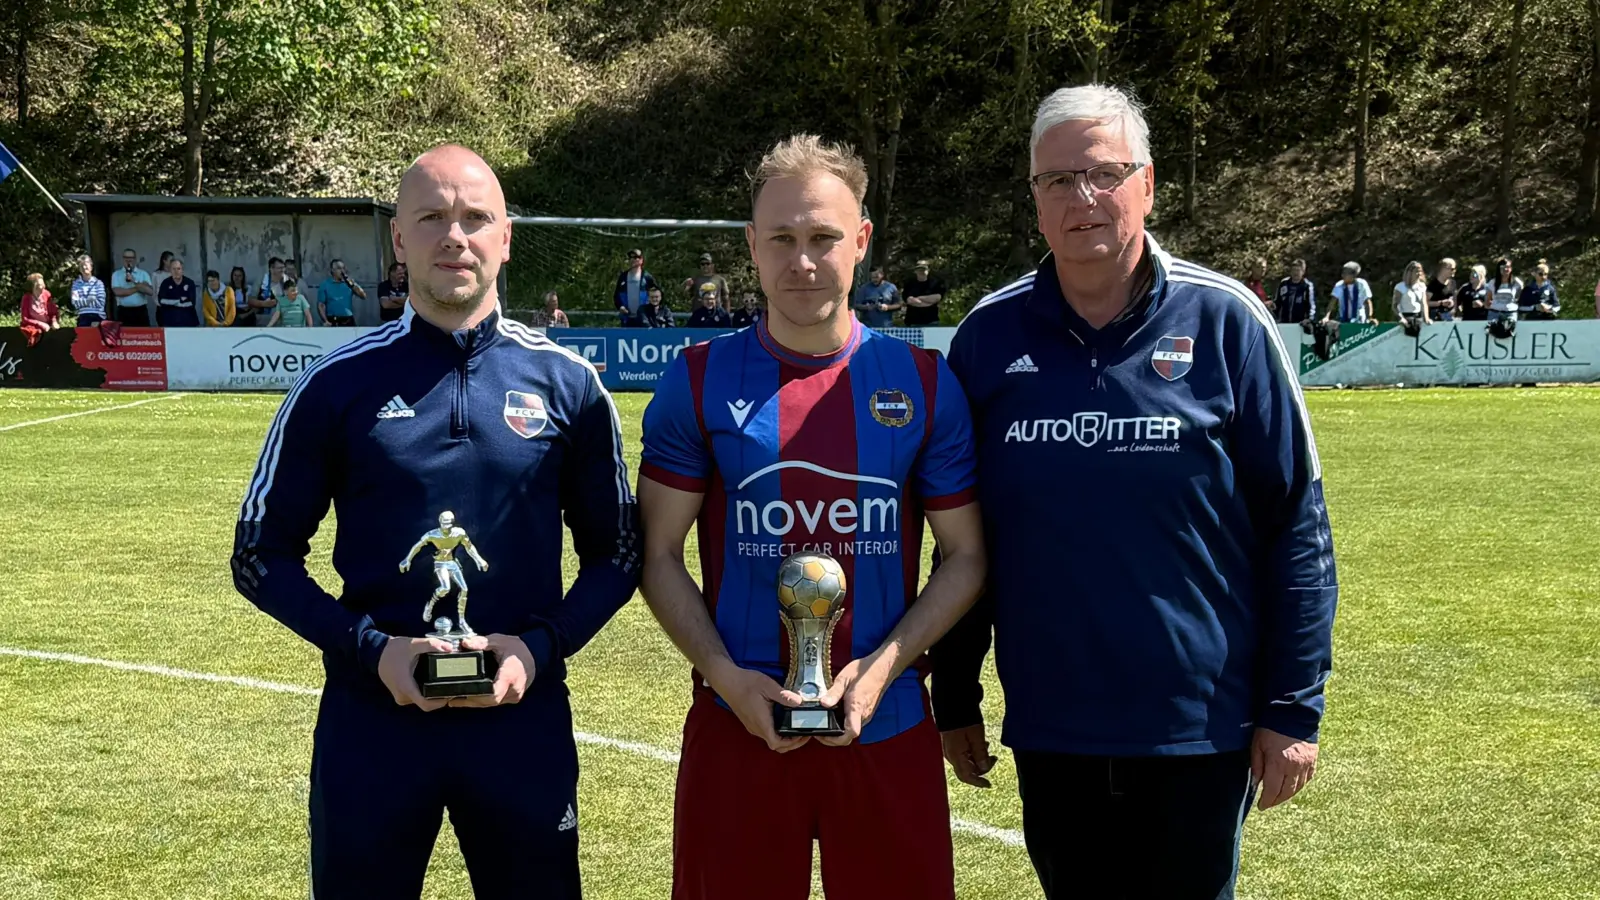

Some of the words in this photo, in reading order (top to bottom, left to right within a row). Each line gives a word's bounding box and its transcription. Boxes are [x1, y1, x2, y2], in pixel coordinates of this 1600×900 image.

[1414, 324, 1575, 360] KAUSLER
[98, 351, 125, 360] 09645
[1005, 365, 1039, 373] adidas
[230, 376, 266, 385] PERFECT
[269, 376, 286, 385] CAR
[619, 371, 658, 381] Werden
[376, 408, 416, 419] adidas
[515, 409, 536, 417] FCV
[736, 498, 898, 535] novem
[738, 542, 797, 557] PERFECT
[802, 541, 832, 556] CAR
